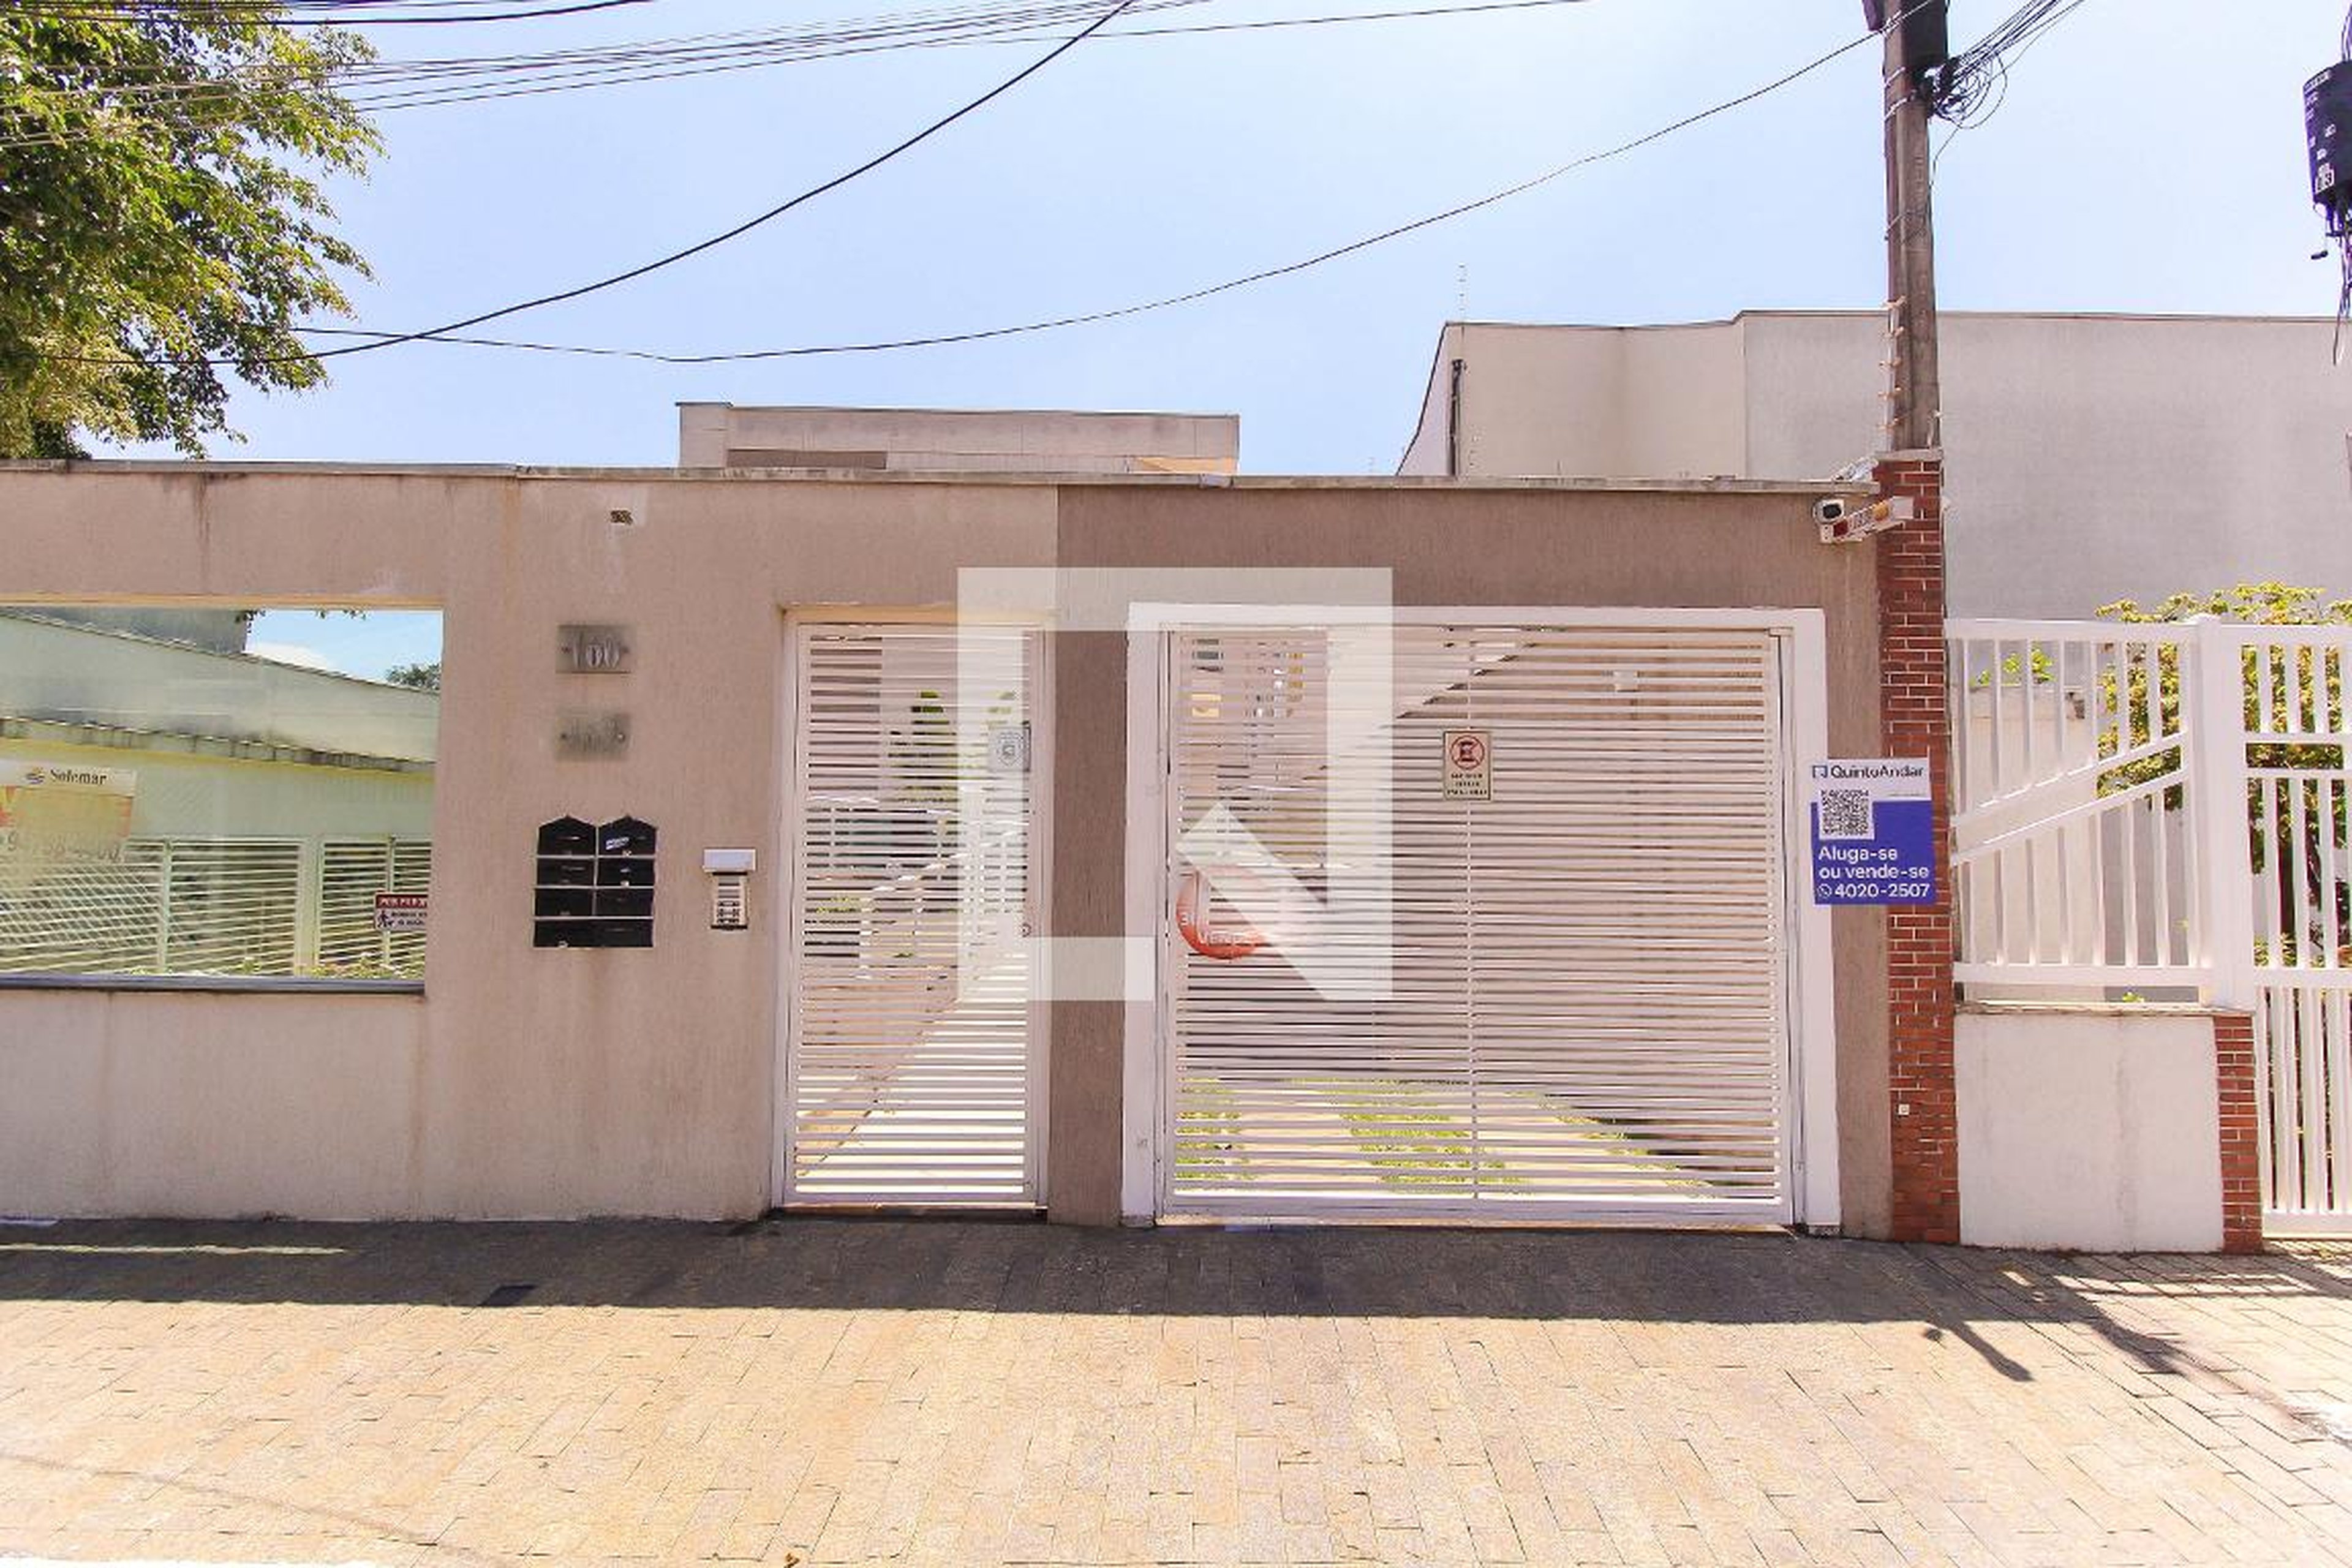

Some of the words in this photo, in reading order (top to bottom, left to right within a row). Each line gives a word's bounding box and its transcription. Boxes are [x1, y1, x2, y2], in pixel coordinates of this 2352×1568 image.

[1831, 764, 1924, 779] QuintoAndar
[1818, 846, 1898, 864] Aluga-se
[1819, 866, 1841, 879] ou
[1844, 864, 1930, 880] vende-se
[1834, 883, 1931, 898] 4020-2507
